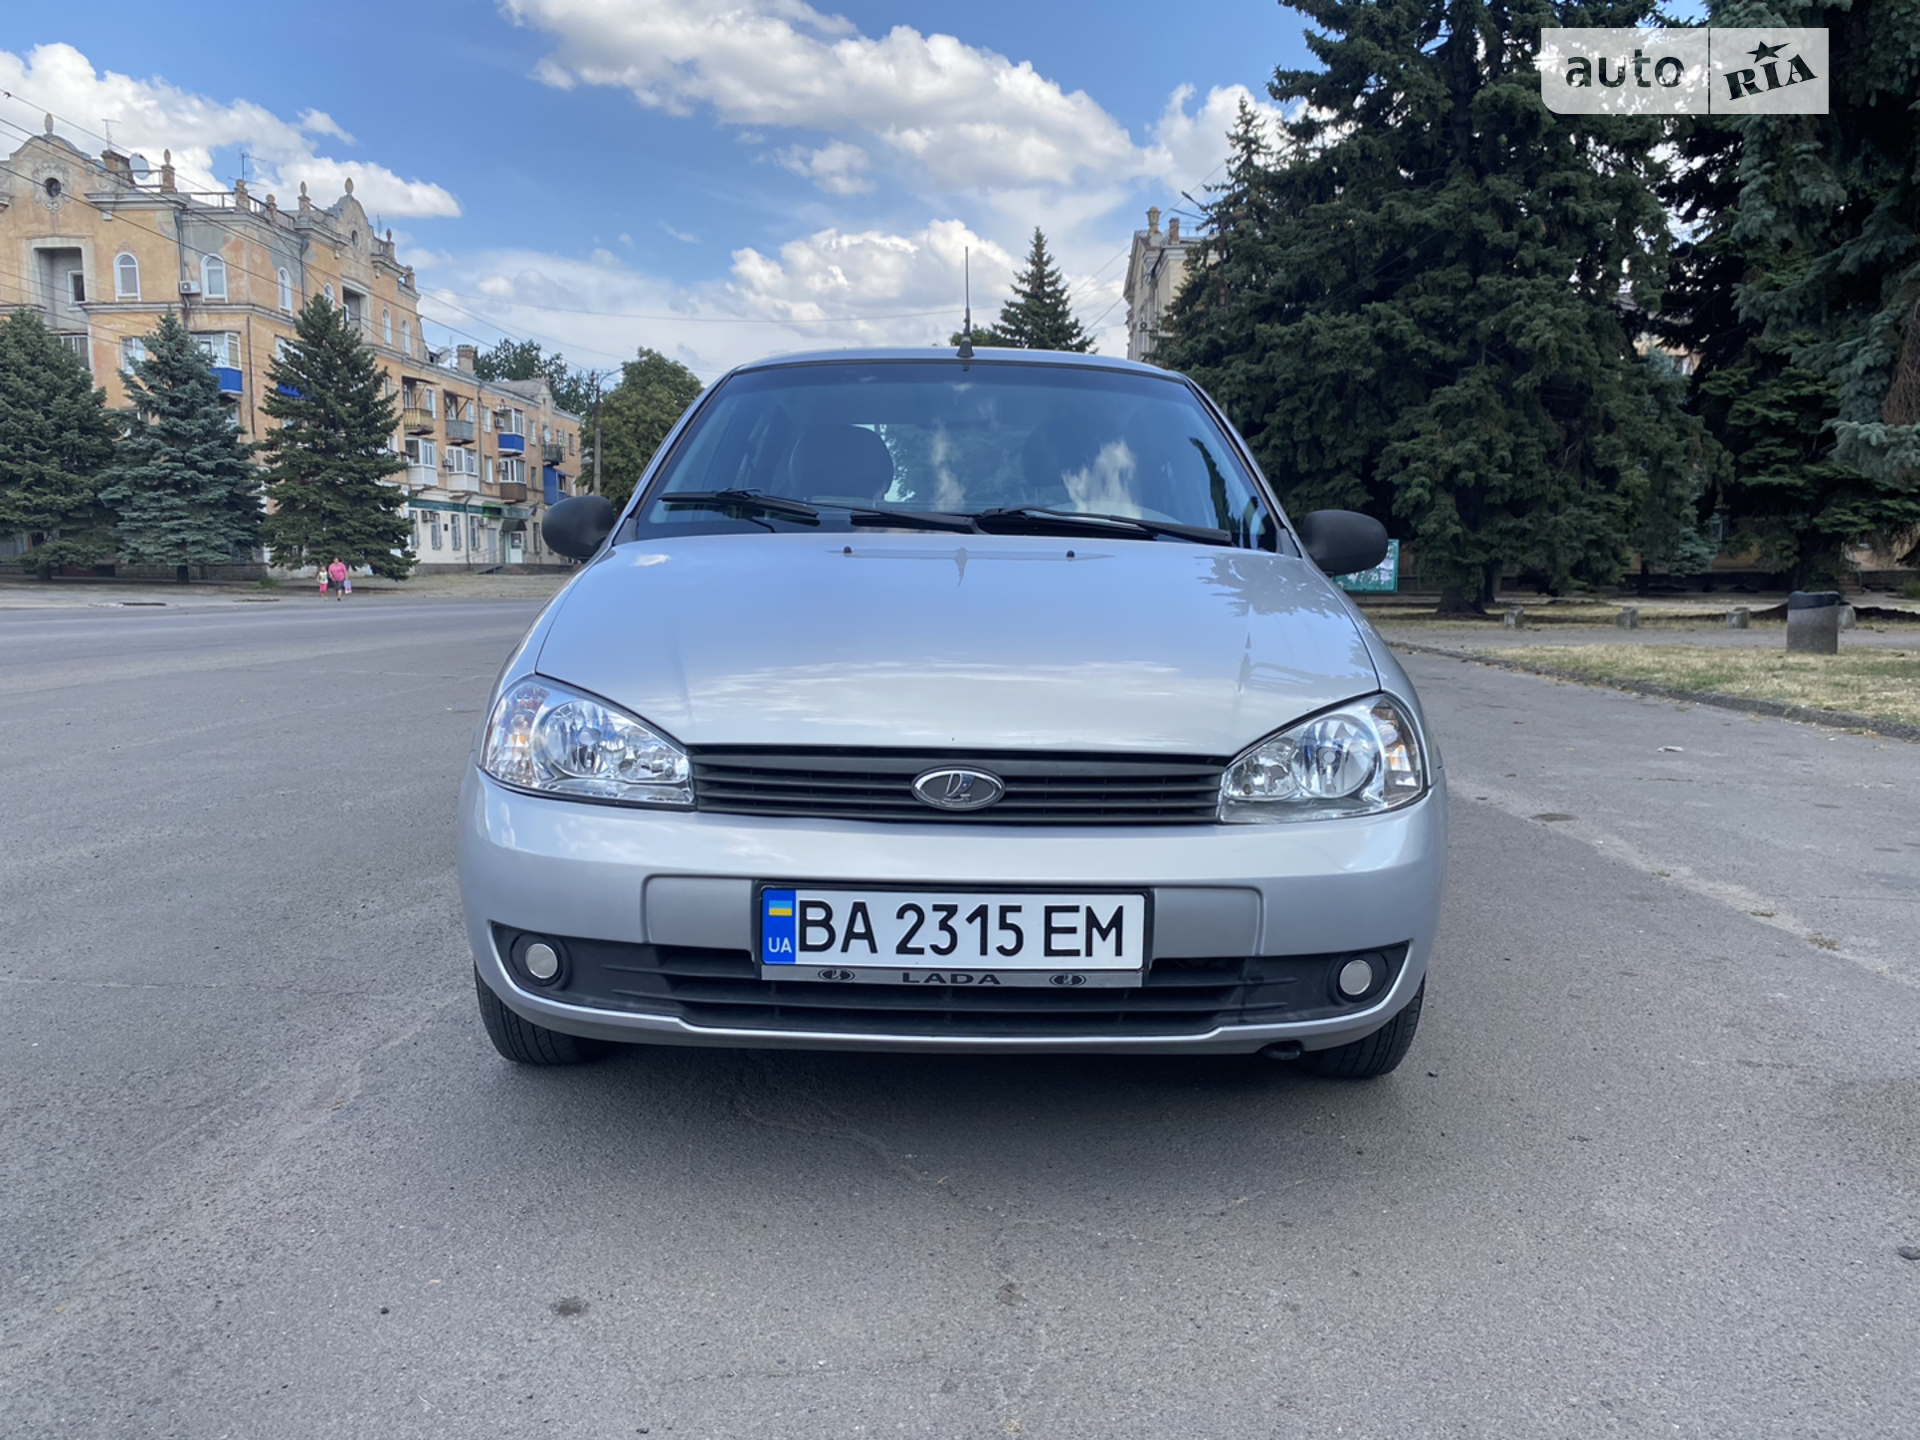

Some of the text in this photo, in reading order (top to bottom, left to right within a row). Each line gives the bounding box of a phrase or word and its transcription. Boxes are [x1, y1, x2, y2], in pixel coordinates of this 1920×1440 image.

[800, 899, 1123, 957] BA 2315 EM
[768, 937, 793, 953] UA
[902, 972, 1002, 985] LADA
